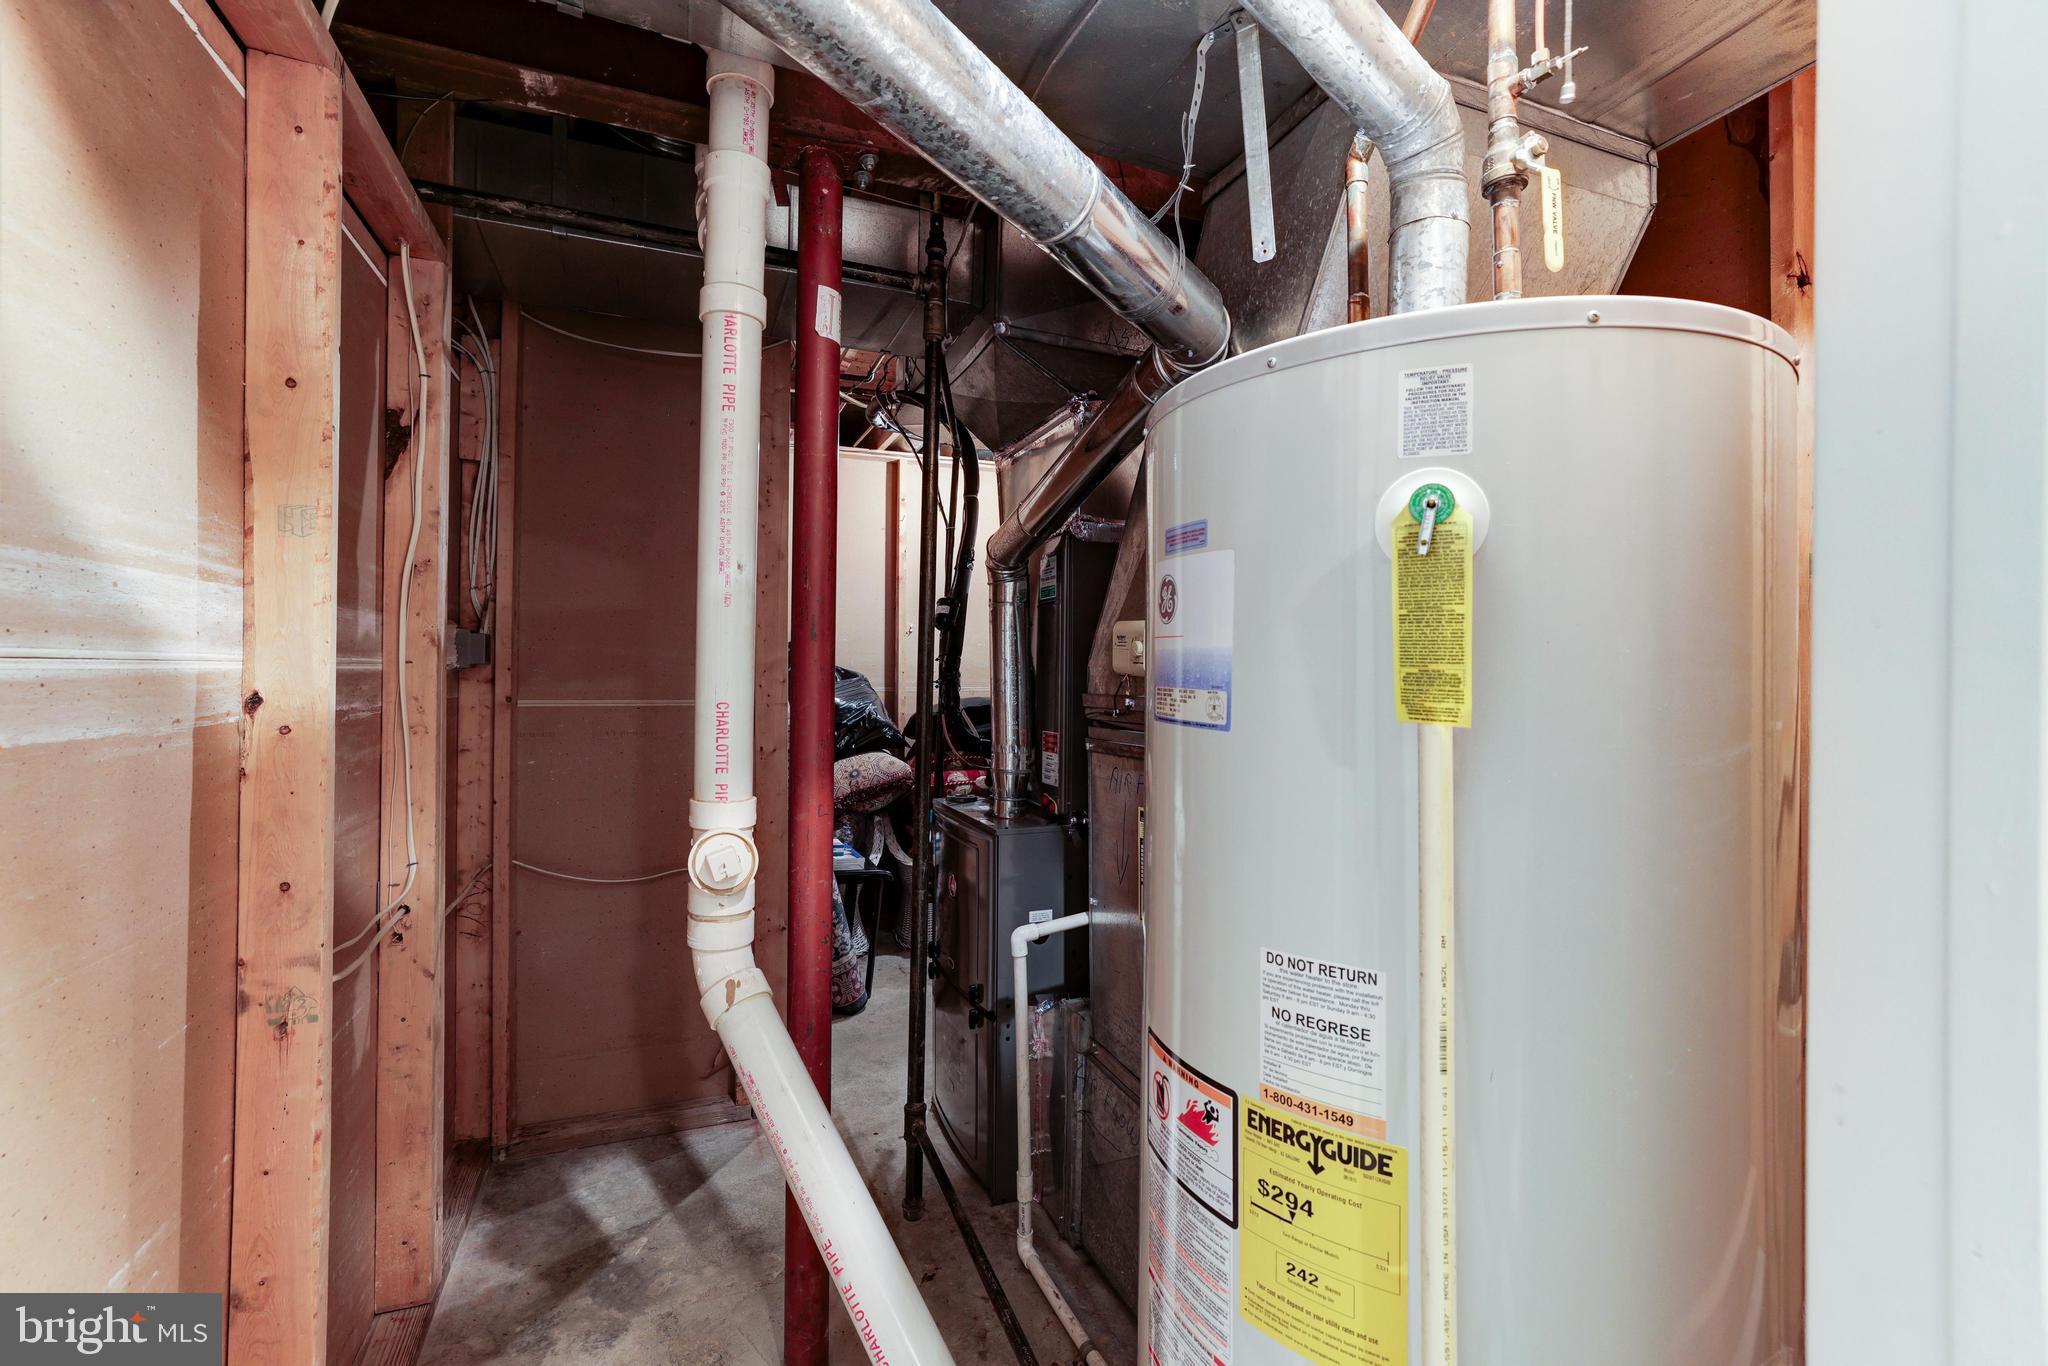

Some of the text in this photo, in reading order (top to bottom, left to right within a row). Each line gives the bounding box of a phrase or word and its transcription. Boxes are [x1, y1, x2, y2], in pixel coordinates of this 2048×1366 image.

[721, 384, 736, 412] PIPE
[715, 702, 730, 774] CHARLOTTE
[1108, 766, 1133, 795] AIR
[1440, 935, 1447, 949] RM
[1266, 951, 1378, 986] DO NOT RETURN
[1305, 973, 1322, 982] heater
[1271, 1006, 1371, 1042] NO REGRESE
[1263, 1088, 1354, 1127] 1-800-431-1549
[1247, 1108, 1393, 1177] ENERGYGUIDE
[1441, 1127, 1449, 1178] 11/15/11
[1257, 1178, 1314, 1218] $294
[1269, 1168, 1363, 1209] Estimated Yearly Operating Cost
[821, 1238, 844, 1278] PIPE
[1286, 1262, 1320, 1288] 242
[1443, 1253, 1449, 1265] IN
[1266, 1287, 1275, 1297] cost
[1276, 1293, 1284, 1302] will
[1286, 1298, 1303, 1313] depend
[1312, 1312, 1323, 1323] your
[1324, 1316, 1339, 1331] utility
[1341, 1324, 1354, 1336] rates
[1356, 1330, 1366, 1340] and
